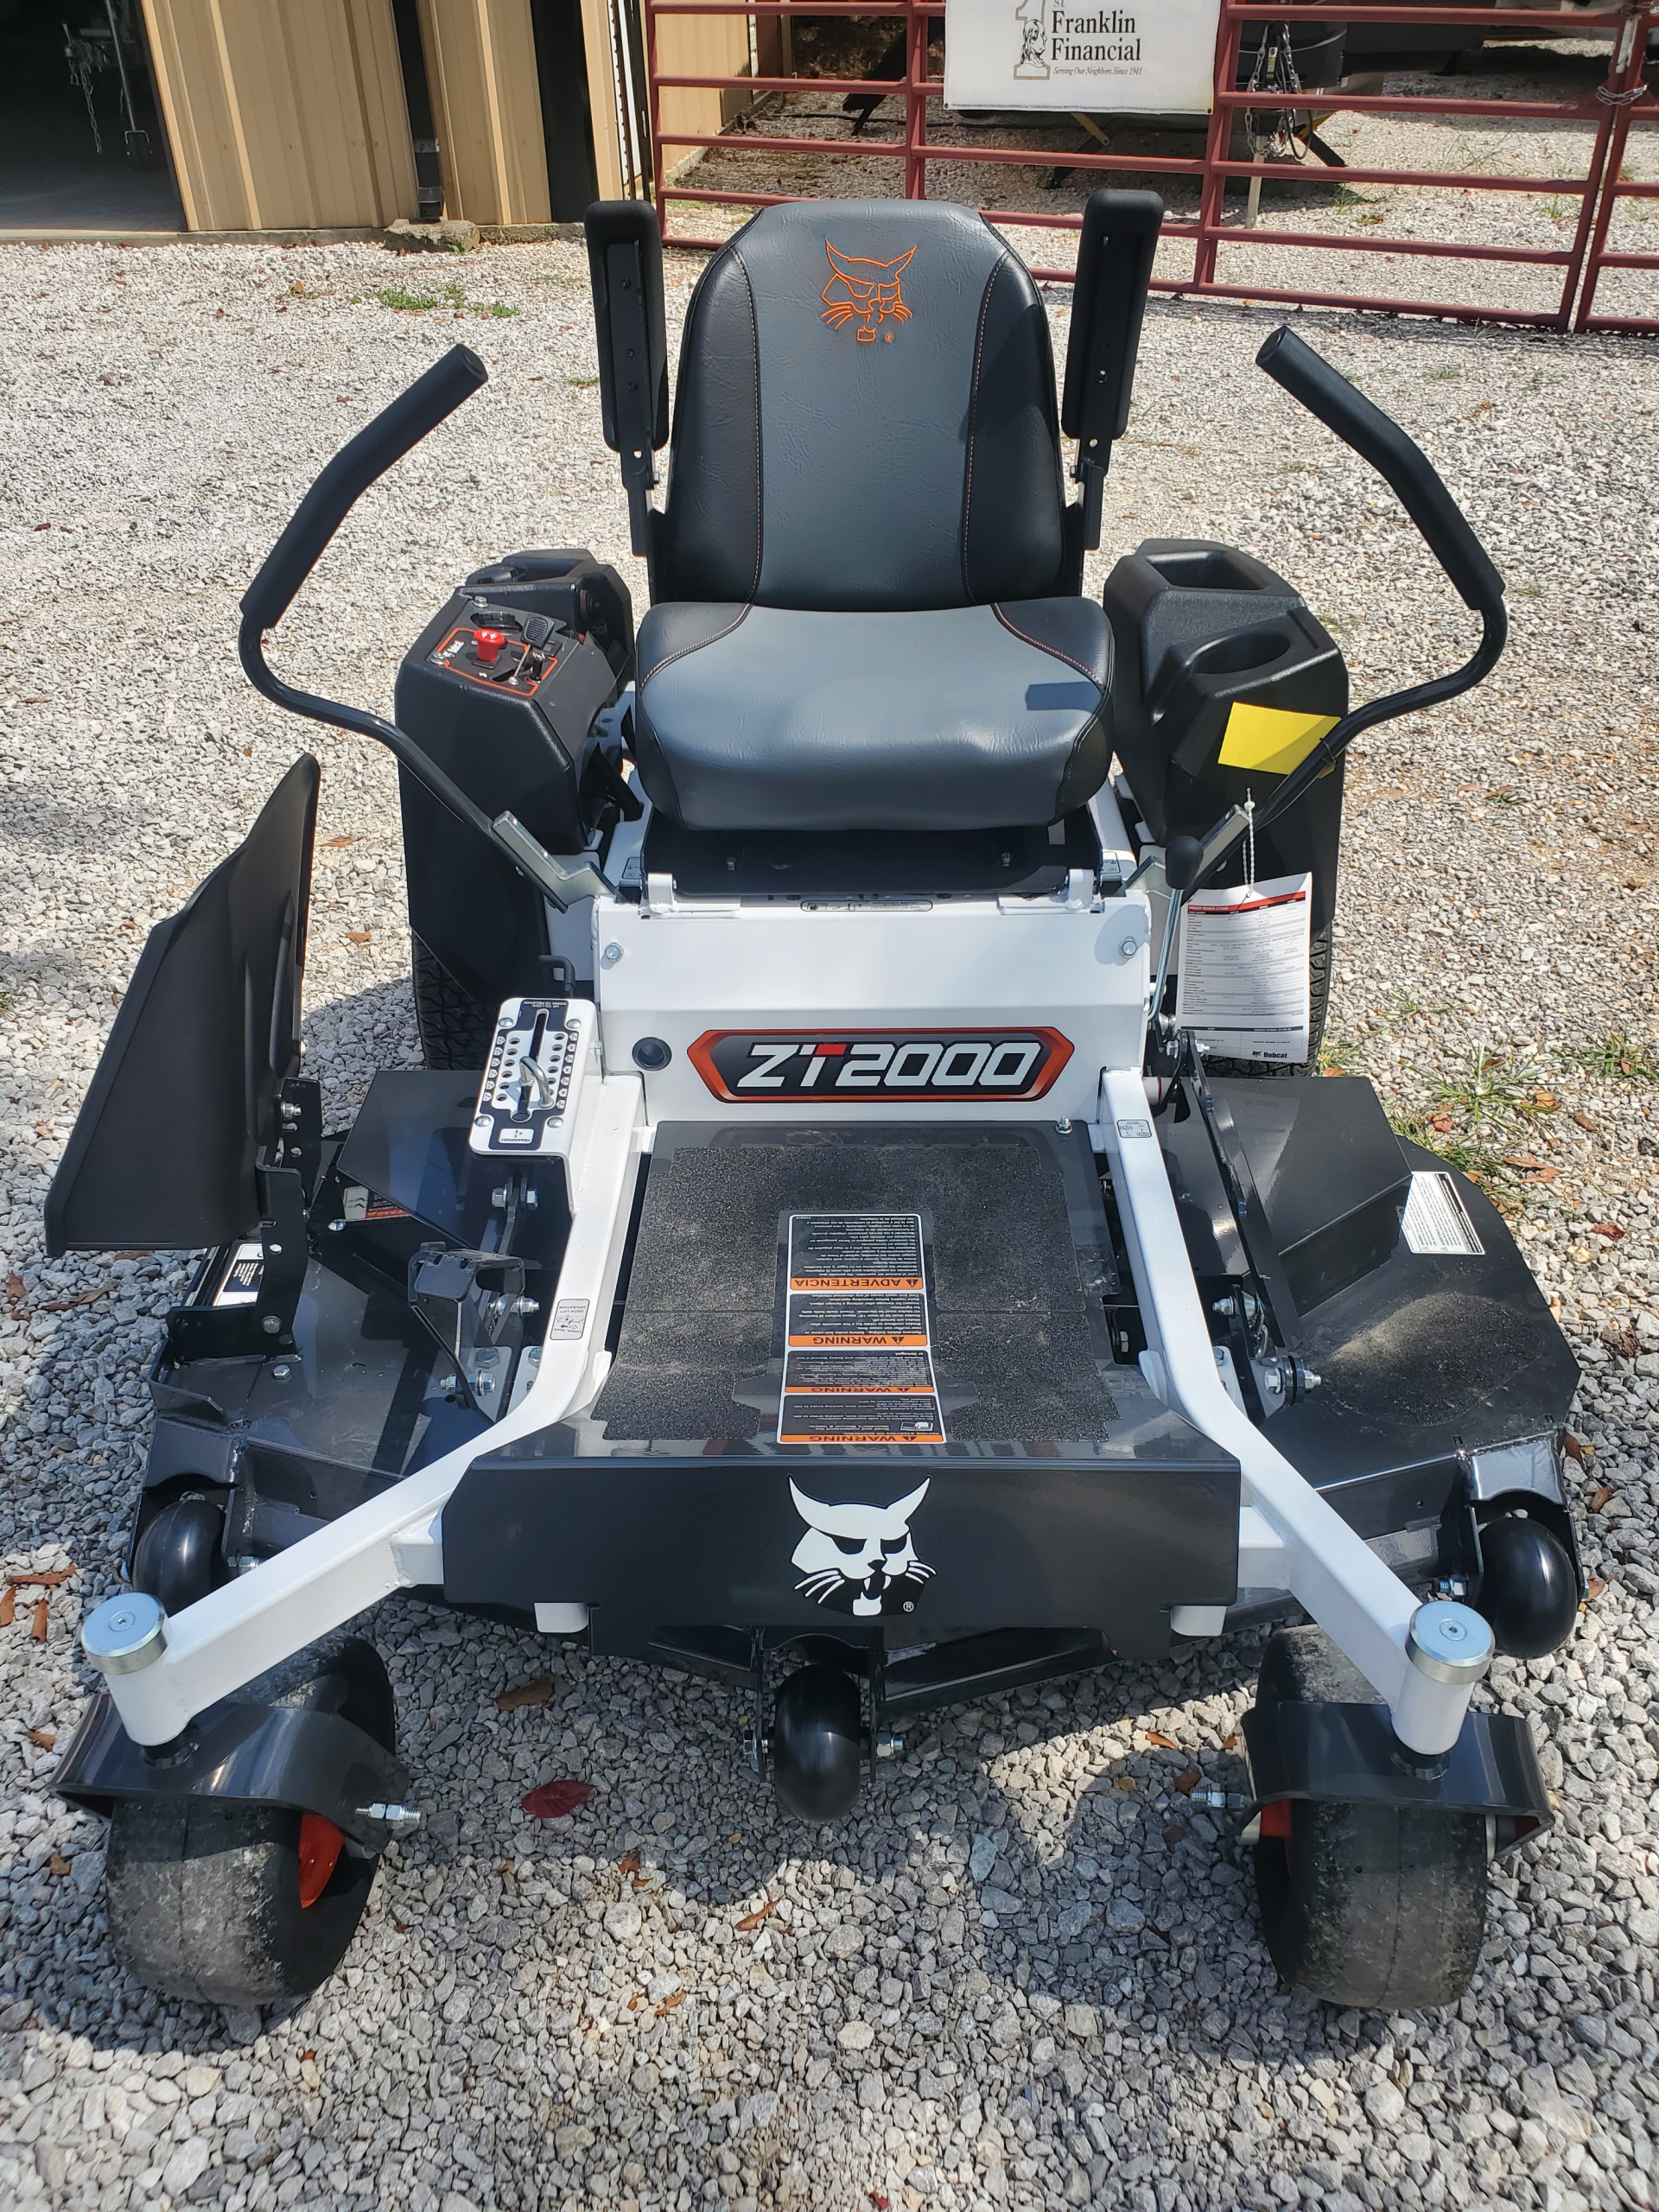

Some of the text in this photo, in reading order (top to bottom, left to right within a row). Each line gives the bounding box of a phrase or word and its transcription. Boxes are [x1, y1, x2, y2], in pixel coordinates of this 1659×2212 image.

[1052, 10, 1136, 34] Franklin
[1051, 37, 1141, 60] Financial
[1053, 67, 1073, 76] Serving
[1086, 67, 1112, 76] Neighbors
[1112, 67, 1128, 76] Since
[1128, 67, 1142, 76] 1941
[737, 1042, 1042, 1087] ZT2000
